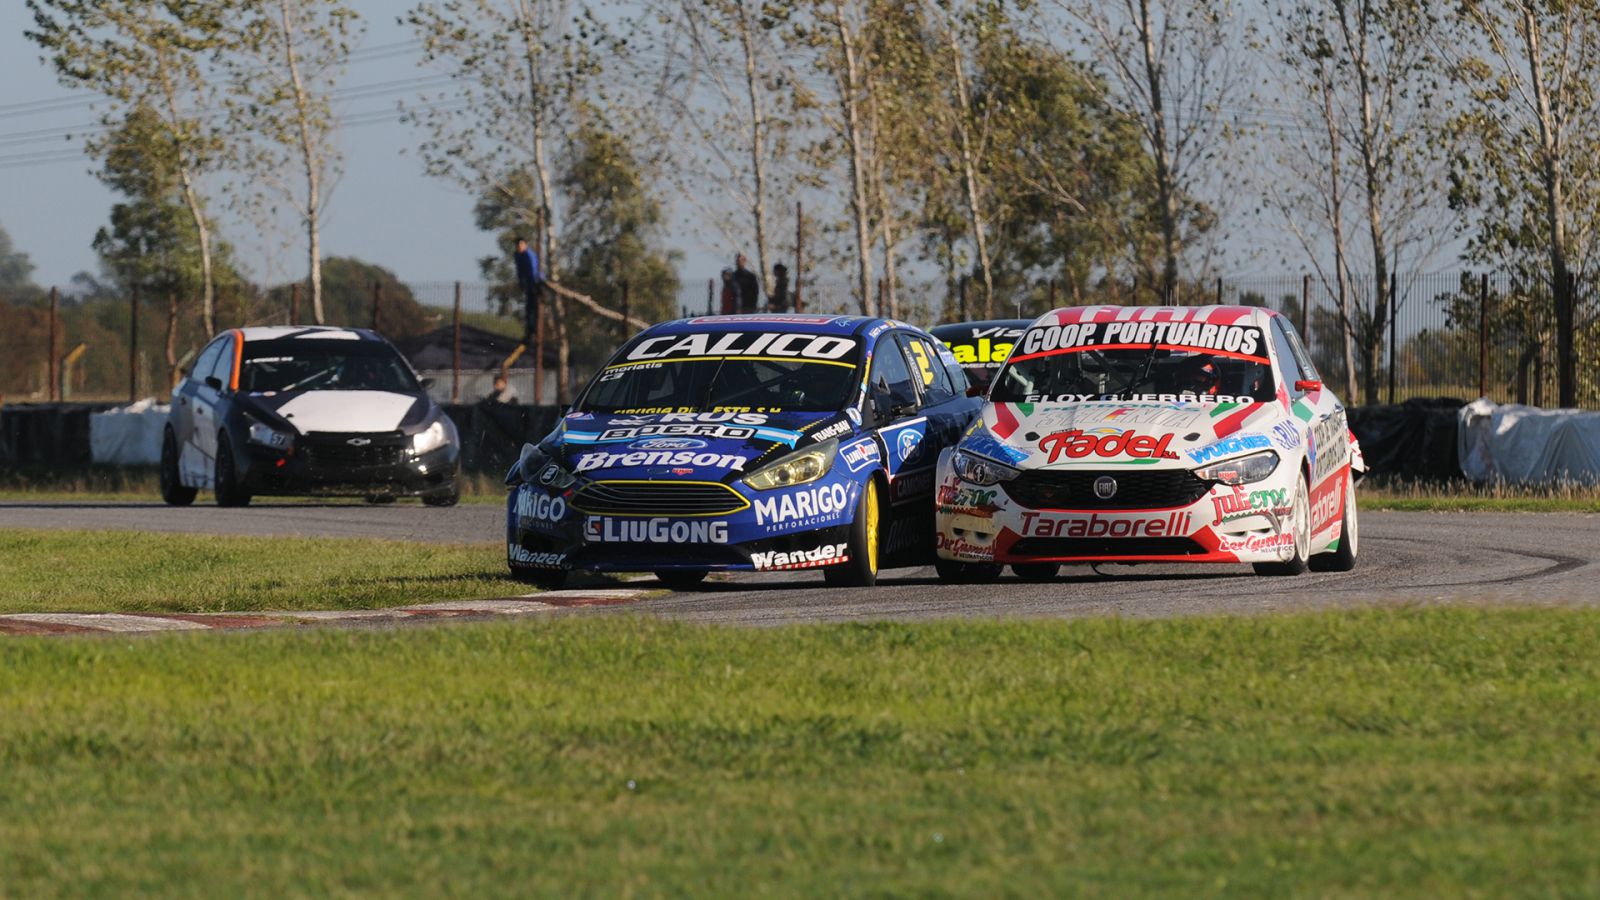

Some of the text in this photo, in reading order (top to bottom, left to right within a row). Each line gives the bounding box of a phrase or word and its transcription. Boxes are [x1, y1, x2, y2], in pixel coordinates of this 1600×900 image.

[627, 332, 857, 360] CALICO
[943, 338, 1015, 363] ala
[1023, 322, 1260, 355] COOP. PORTUARIOS
[909, 340, 934, 386] 2
[1025, 393, 1095, 404] ELOY
[659, 412, 769, 426] RUS
[271, 432, 286, 445] 57
[1039, 429, 1175, 465] Fadel
[542, 467, 557, 481] 2
[571, 450, 747, 475] Brenson
[753, 483, 847, 526] MARIGO
[766, 512, 840, 532] PERFORACIONES
[1021, 511, 1192, 537] Taraborelli
[750, 542, 848, 569] Wander
